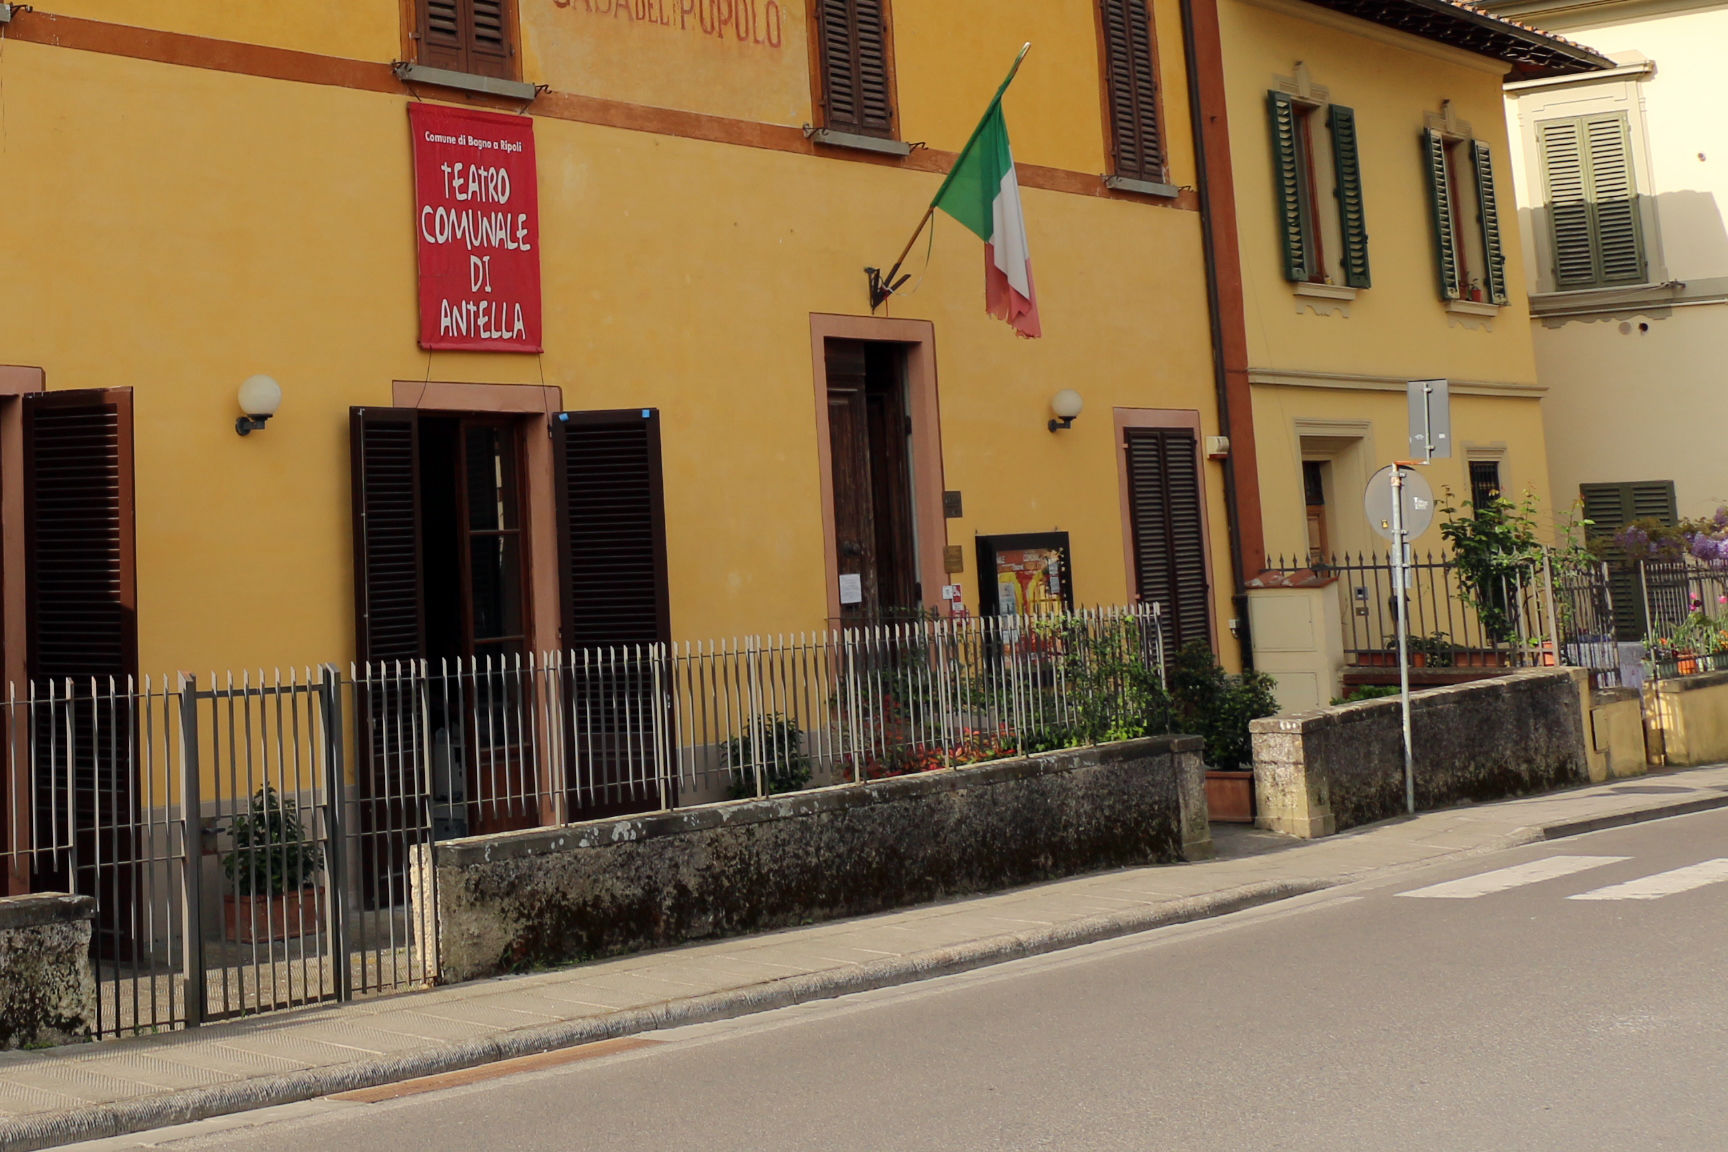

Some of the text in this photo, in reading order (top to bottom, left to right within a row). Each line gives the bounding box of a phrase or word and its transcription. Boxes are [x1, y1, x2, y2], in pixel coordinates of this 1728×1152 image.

[424, 130, 522, 154] Comune di Bagno a Ripoli
[441, 162, 510, 204] TEATRO
[422, 204, 531, 251] COMUNALE
[469, 254, 492, 293] DI
[440, 298, 526, 340] ANTELLA
